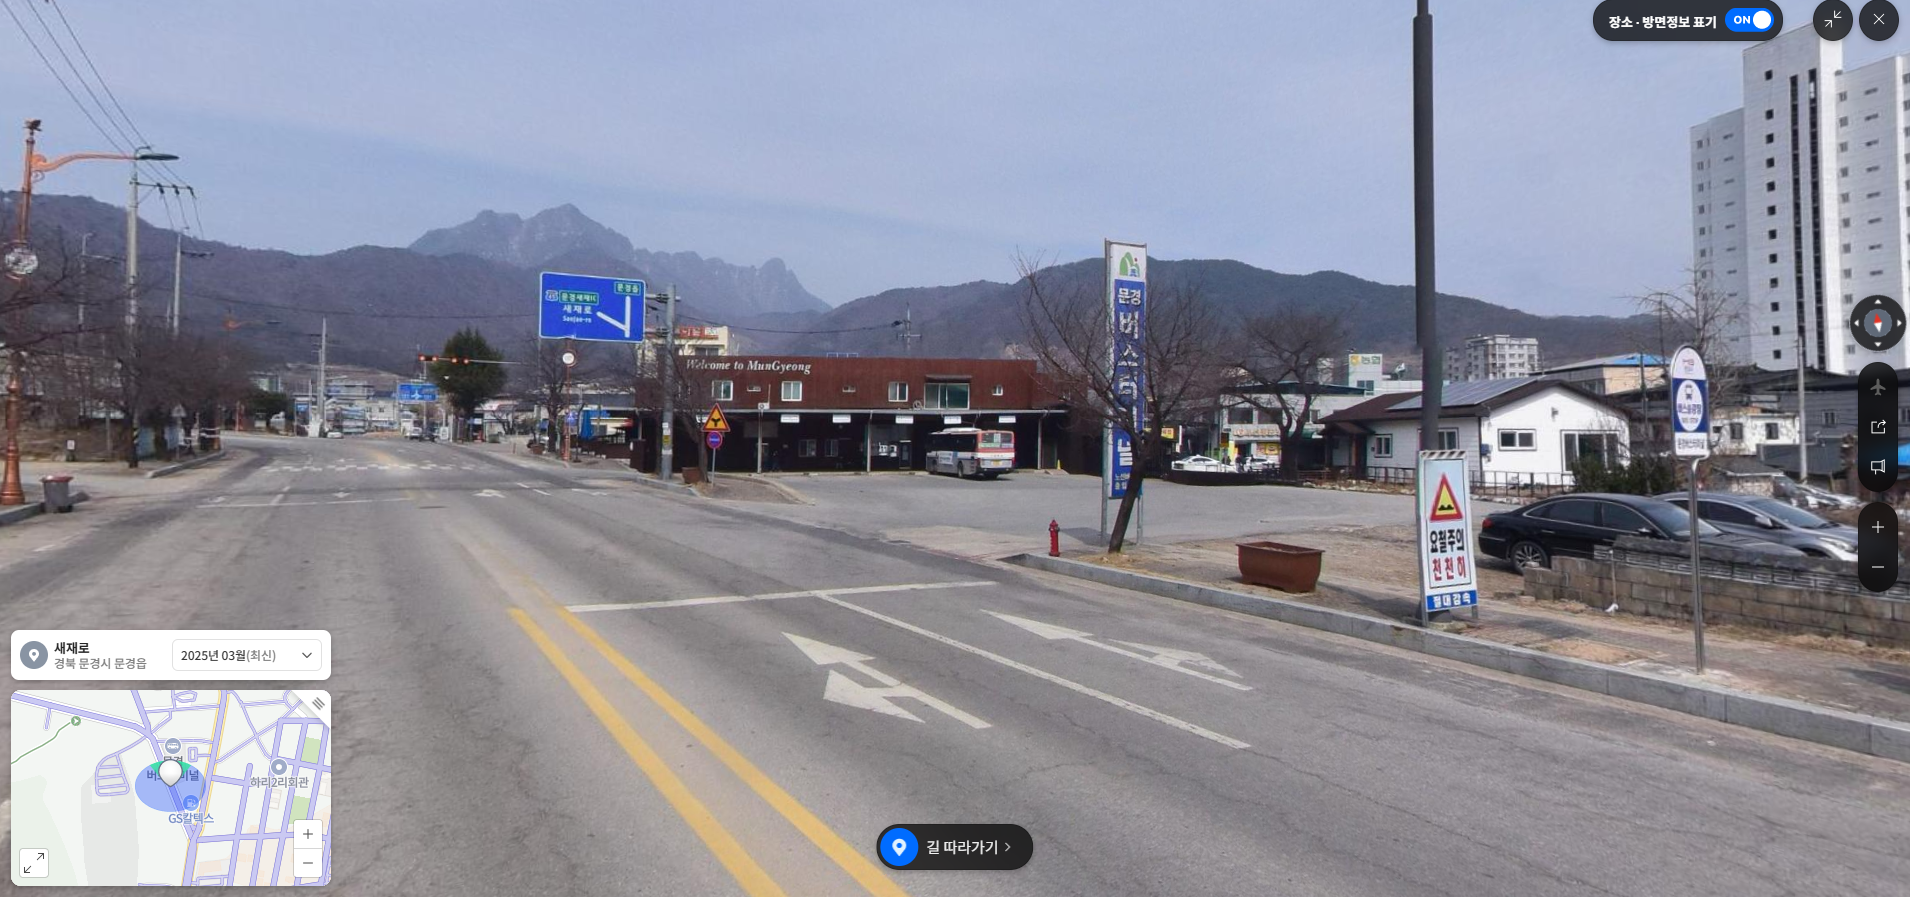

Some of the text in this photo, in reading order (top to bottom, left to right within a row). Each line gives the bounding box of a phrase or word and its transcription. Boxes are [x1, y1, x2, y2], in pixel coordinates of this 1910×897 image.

[617, 283, 639, 293] 문경읍
[1118, 287, 1142, 306] 문경
[562, 304, 593, 315] 새재로
[687, 359, 811, 374] Welcome to MunGyeong
[1430, 529, 1465, 553] 요철주의
[1433, 593, 1471, 608] 절대감속
